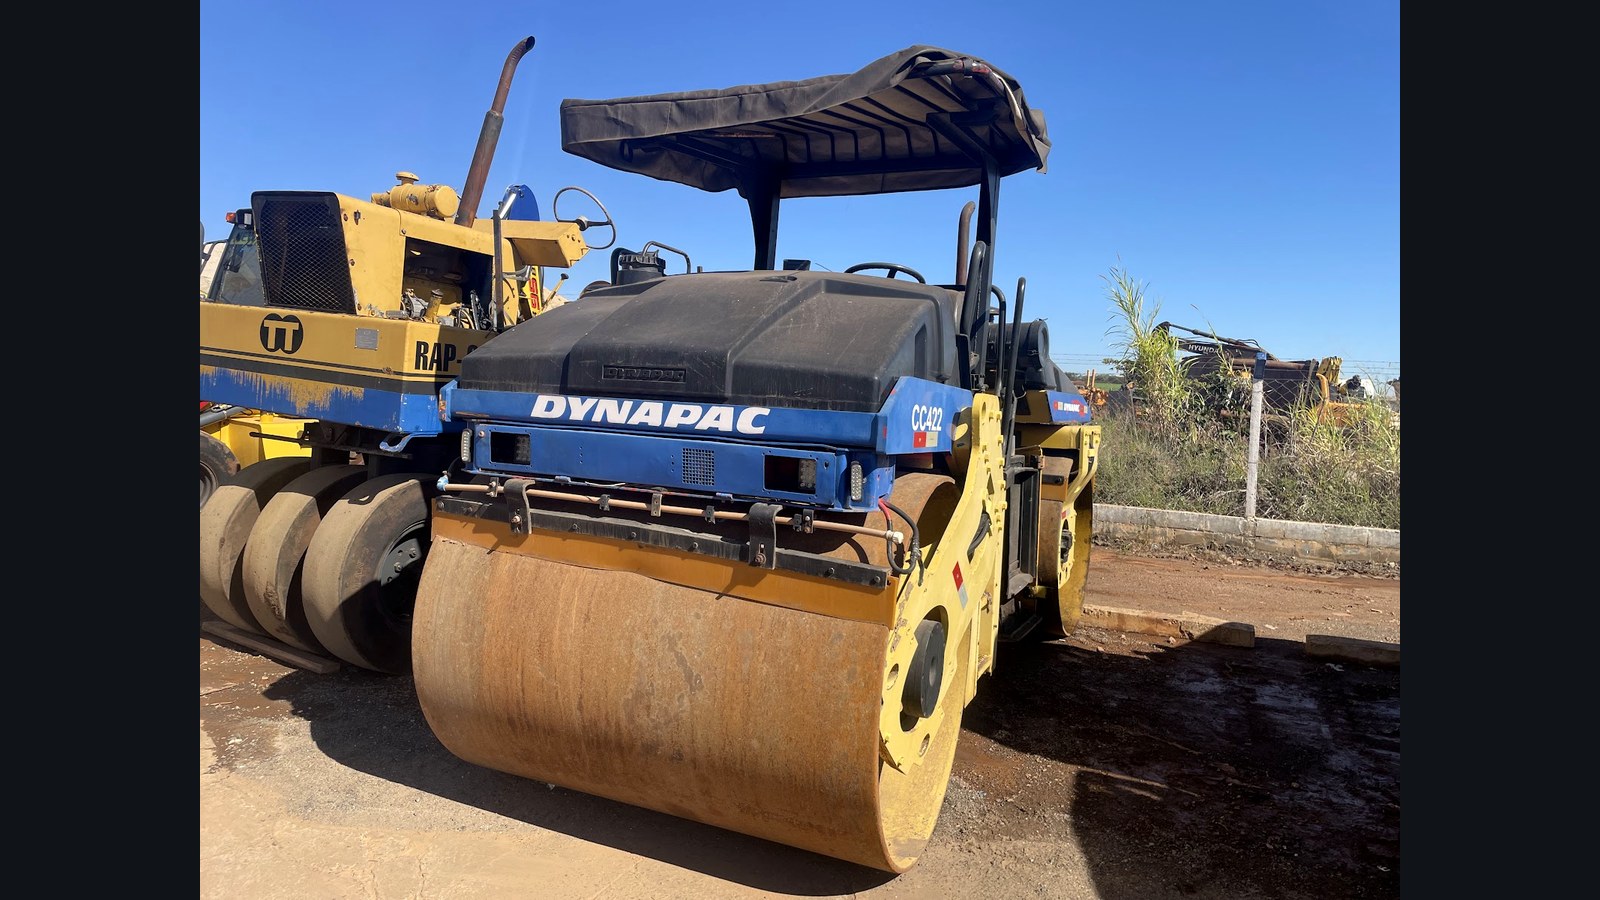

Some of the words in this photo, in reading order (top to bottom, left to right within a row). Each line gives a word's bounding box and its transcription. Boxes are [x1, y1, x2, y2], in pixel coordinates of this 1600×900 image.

[414, 340, 478, 372] RAP-
[1188, 344, 1220, 354] HYUNDA
[530, 394, 771, 435] DYNAPAC
[911, 404, 943, 432] CC422
